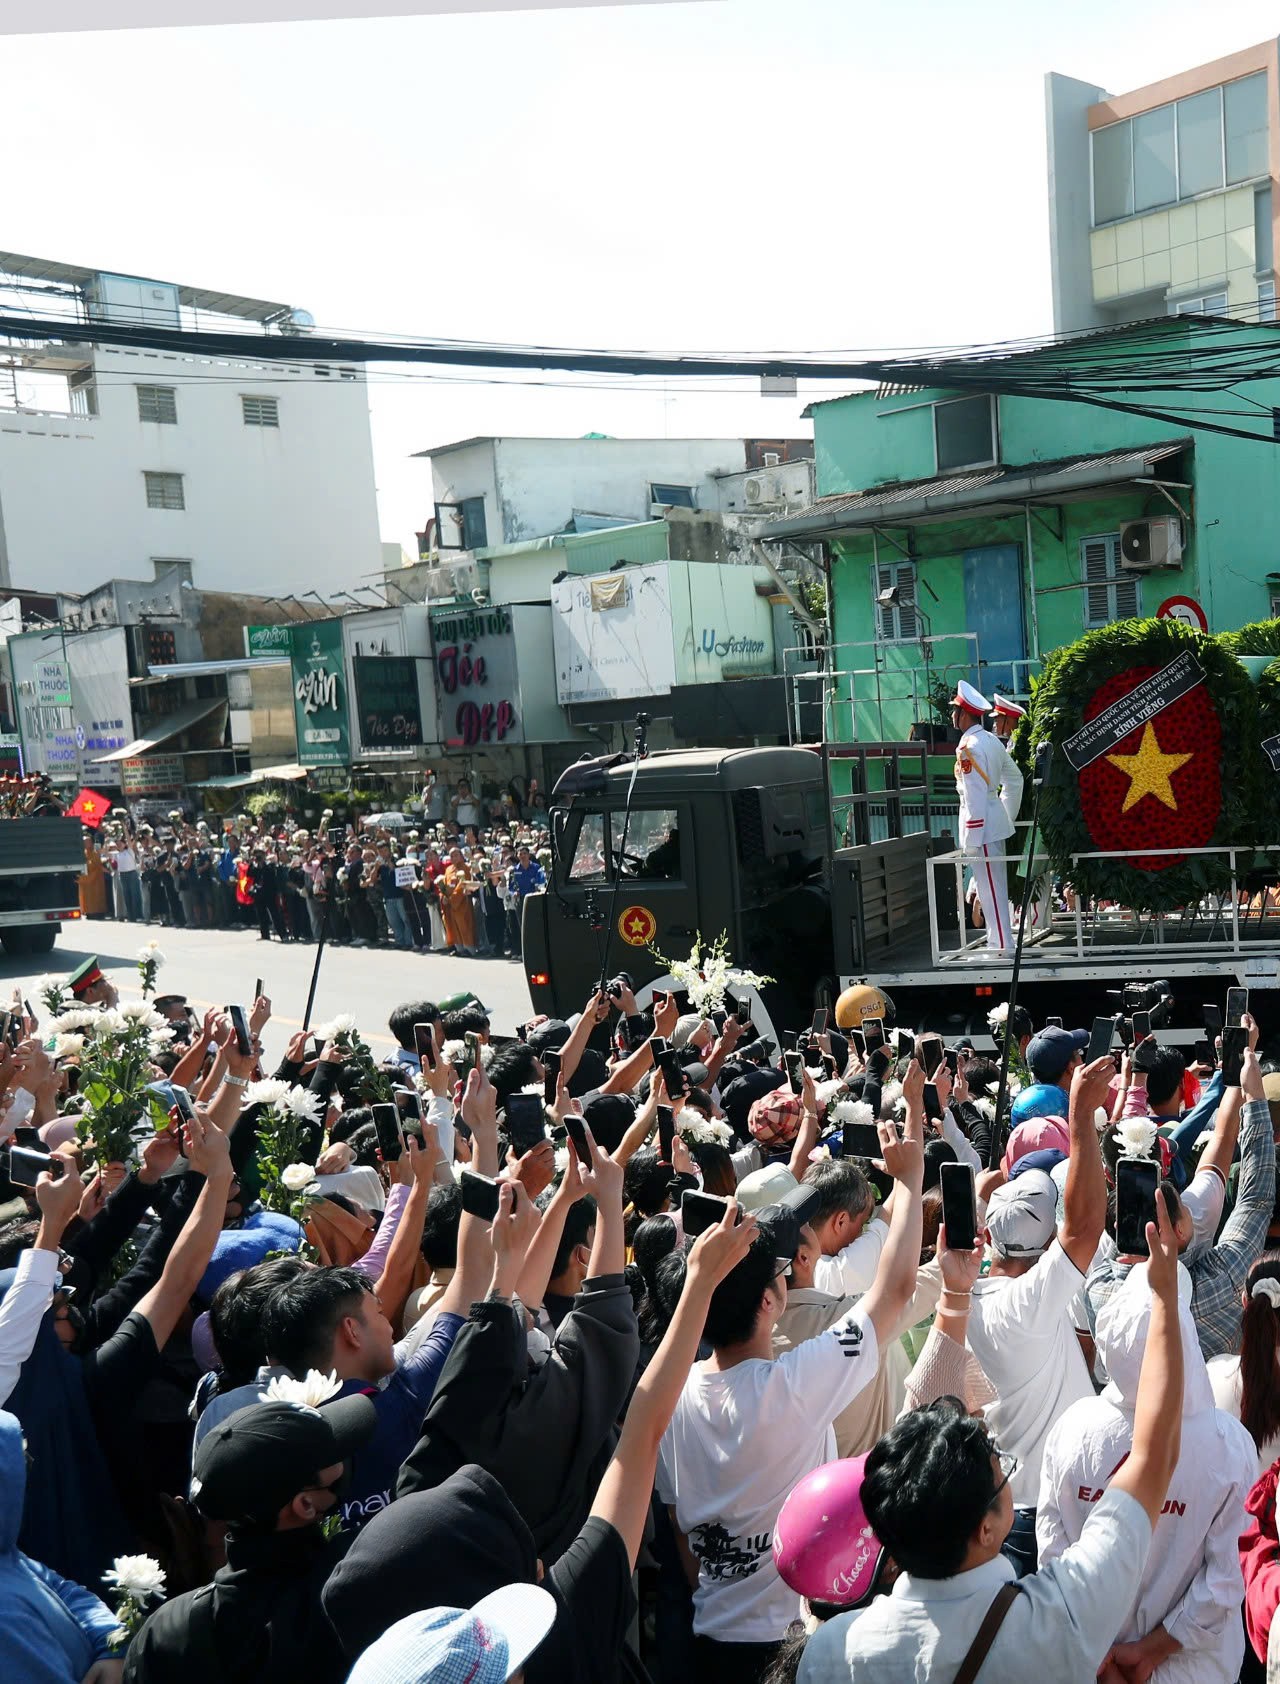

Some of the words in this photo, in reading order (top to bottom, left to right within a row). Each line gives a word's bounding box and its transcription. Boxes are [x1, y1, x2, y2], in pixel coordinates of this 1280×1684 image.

[1101, 707, 1119, 721] QUỐC
[1119, 700, 1131, 710] GIA
[1140, 683, 1152, 695] TÌM
[1112, 715, 1139, 739] KÍNH
[1136, 697, 1166, 720] VIẾNG
[1113, 710, 1131, 725] DANH
[1157, 679, 1171, 692] CỐT
[830, 1546, 871, 1595] Choose
